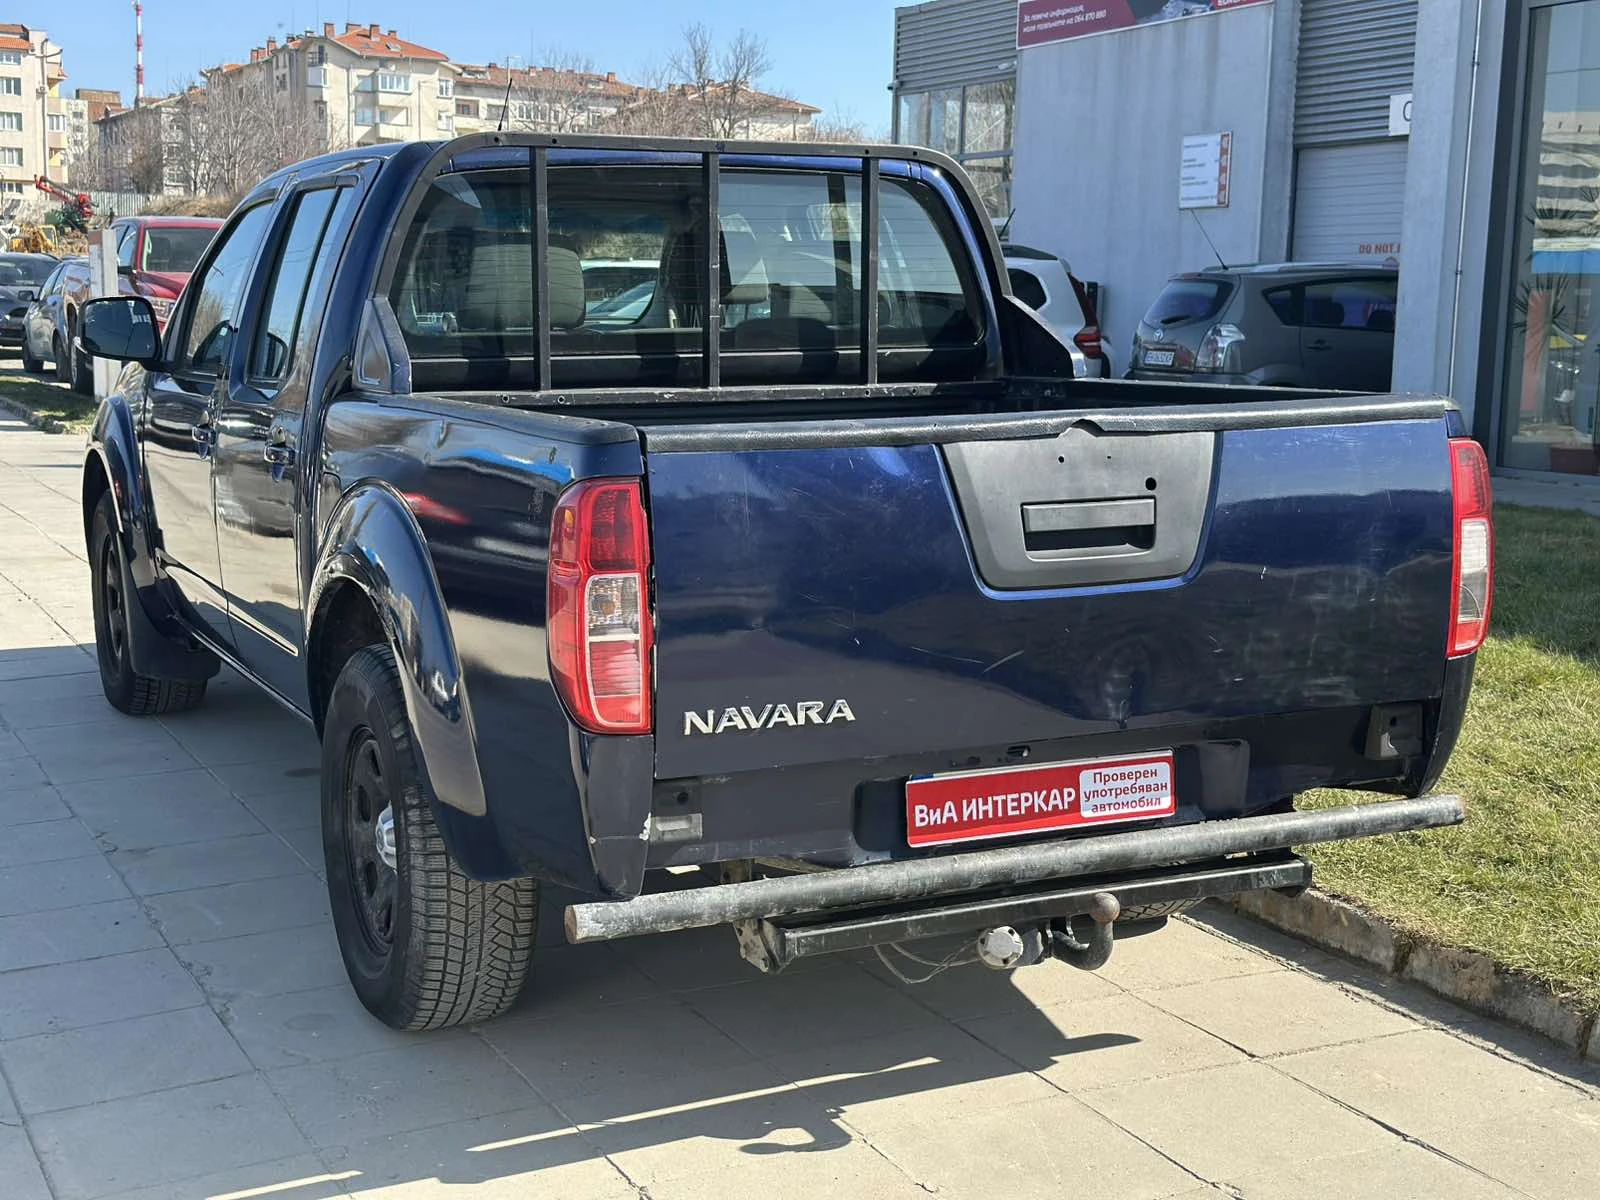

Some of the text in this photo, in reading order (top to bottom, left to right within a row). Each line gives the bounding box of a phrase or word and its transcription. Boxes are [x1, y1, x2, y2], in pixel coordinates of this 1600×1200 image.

[1375, 243, 1393, 254] NOT
[683, 699, 857, 736] NAVARA
[1093, 767, 1159, 785] Проверен
[1083, 781, 1168, 803] употребяван
[914, 787, 1077, 828] ВиА ИНТЕРКАР
[1091, 796, 1161, 814] автомобил
